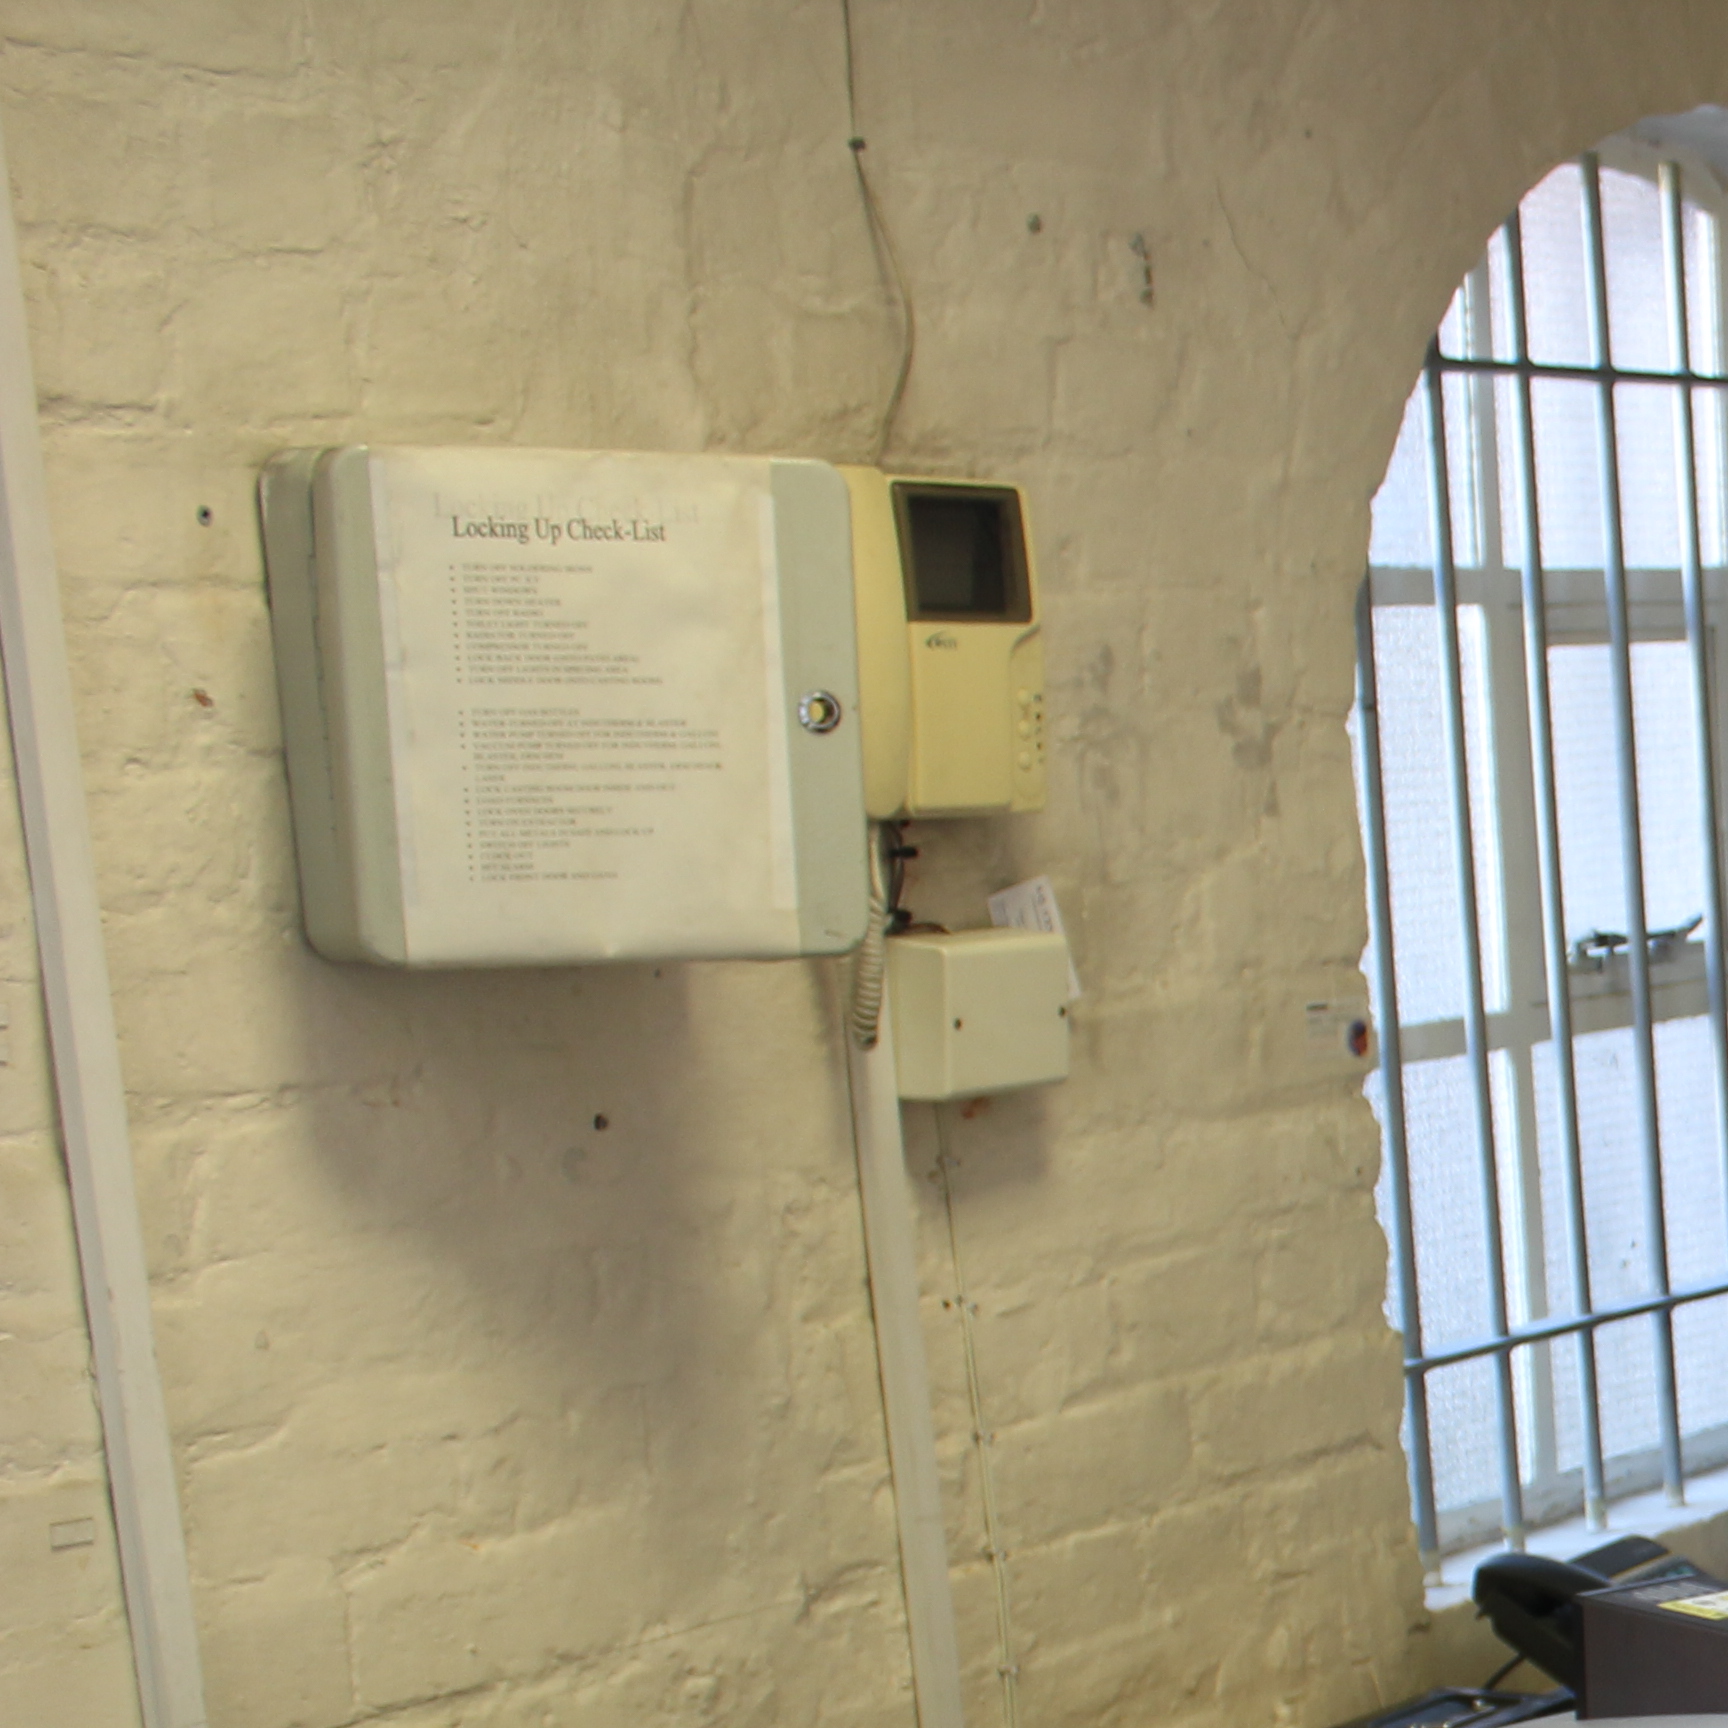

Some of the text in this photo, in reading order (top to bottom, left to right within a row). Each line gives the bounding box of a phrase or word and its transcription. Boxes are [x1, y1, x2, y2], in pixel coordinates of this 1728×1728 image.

[452, 515, 667, 546] Locking Up Check-List
